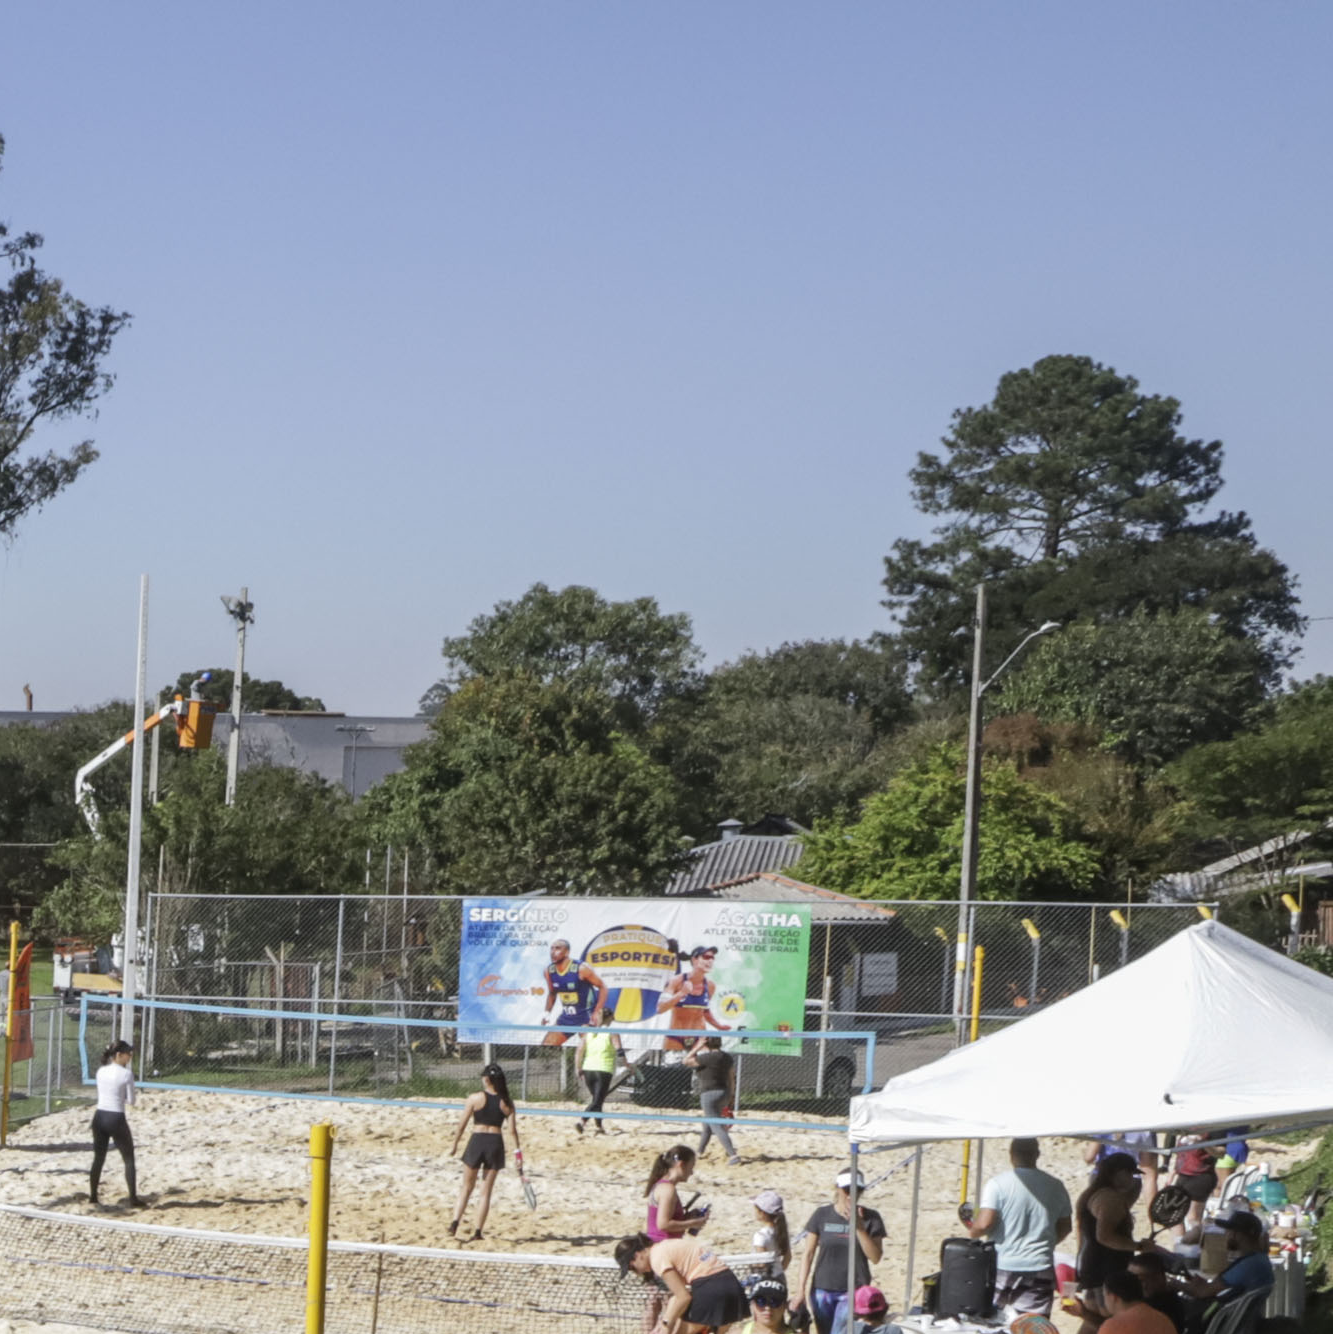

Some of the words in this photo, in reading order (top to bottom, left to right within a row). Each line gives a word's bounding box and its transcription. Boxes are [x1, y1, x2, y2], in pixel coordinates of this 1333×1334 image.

[469, 907, 568, 922] SERGINHO
[715, 908, 802, 928] ÁGATHA
[518, 924, 558, 932] SELEÇÃO
[703, 928, 738, 936] ATLETA
[757, 929, 801, 938] SELEÇÃO
[602, 932, 663, 944] PRATIQUE
[729, 936, 785, 945] BRASILEIRA
[770, 945, 799, 953] PRAIA
[591, 951, 676, 967] ESPORTES!
